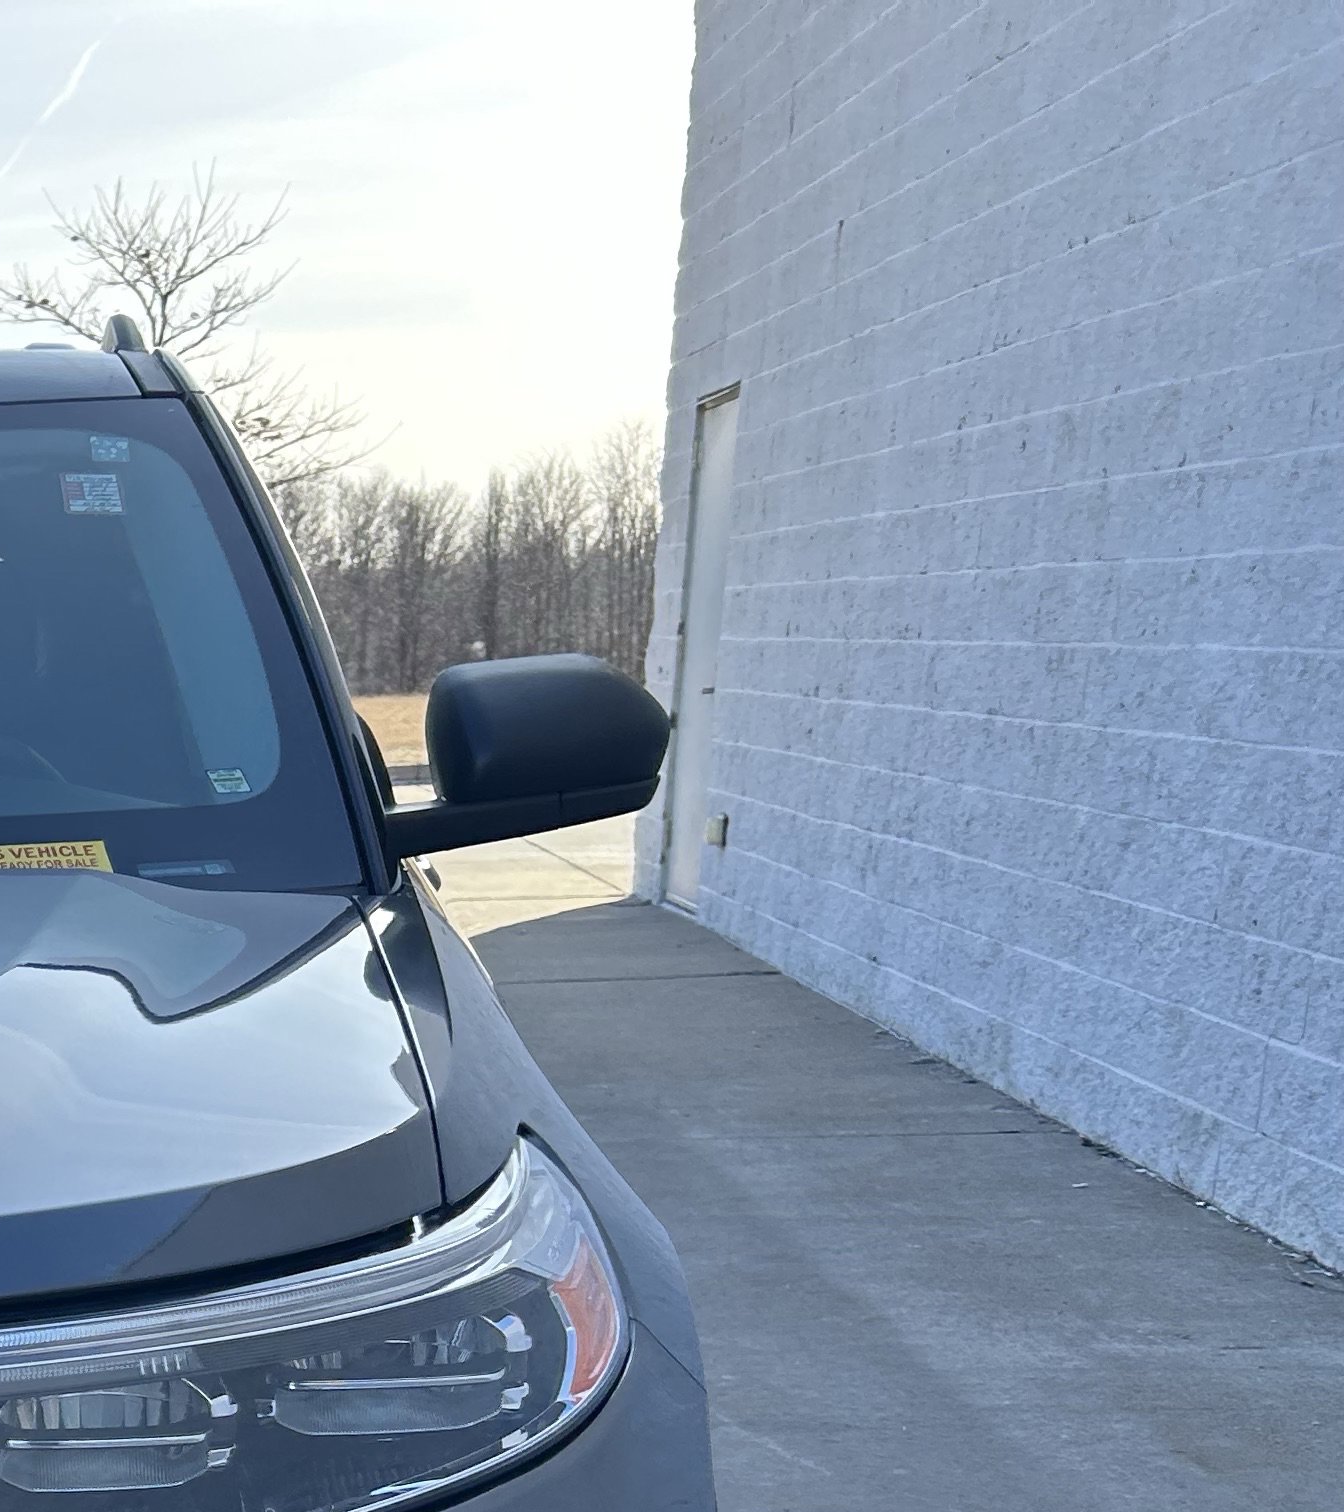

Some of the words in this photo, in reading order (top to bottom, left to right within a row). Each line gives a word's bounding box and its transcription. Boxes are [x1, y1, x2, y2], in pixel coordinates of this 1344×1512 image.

[8, 844, 97, 859] VEHICLE
[36, 860, 63, 869] FOR
[66, 858, 99, 868] SALE
